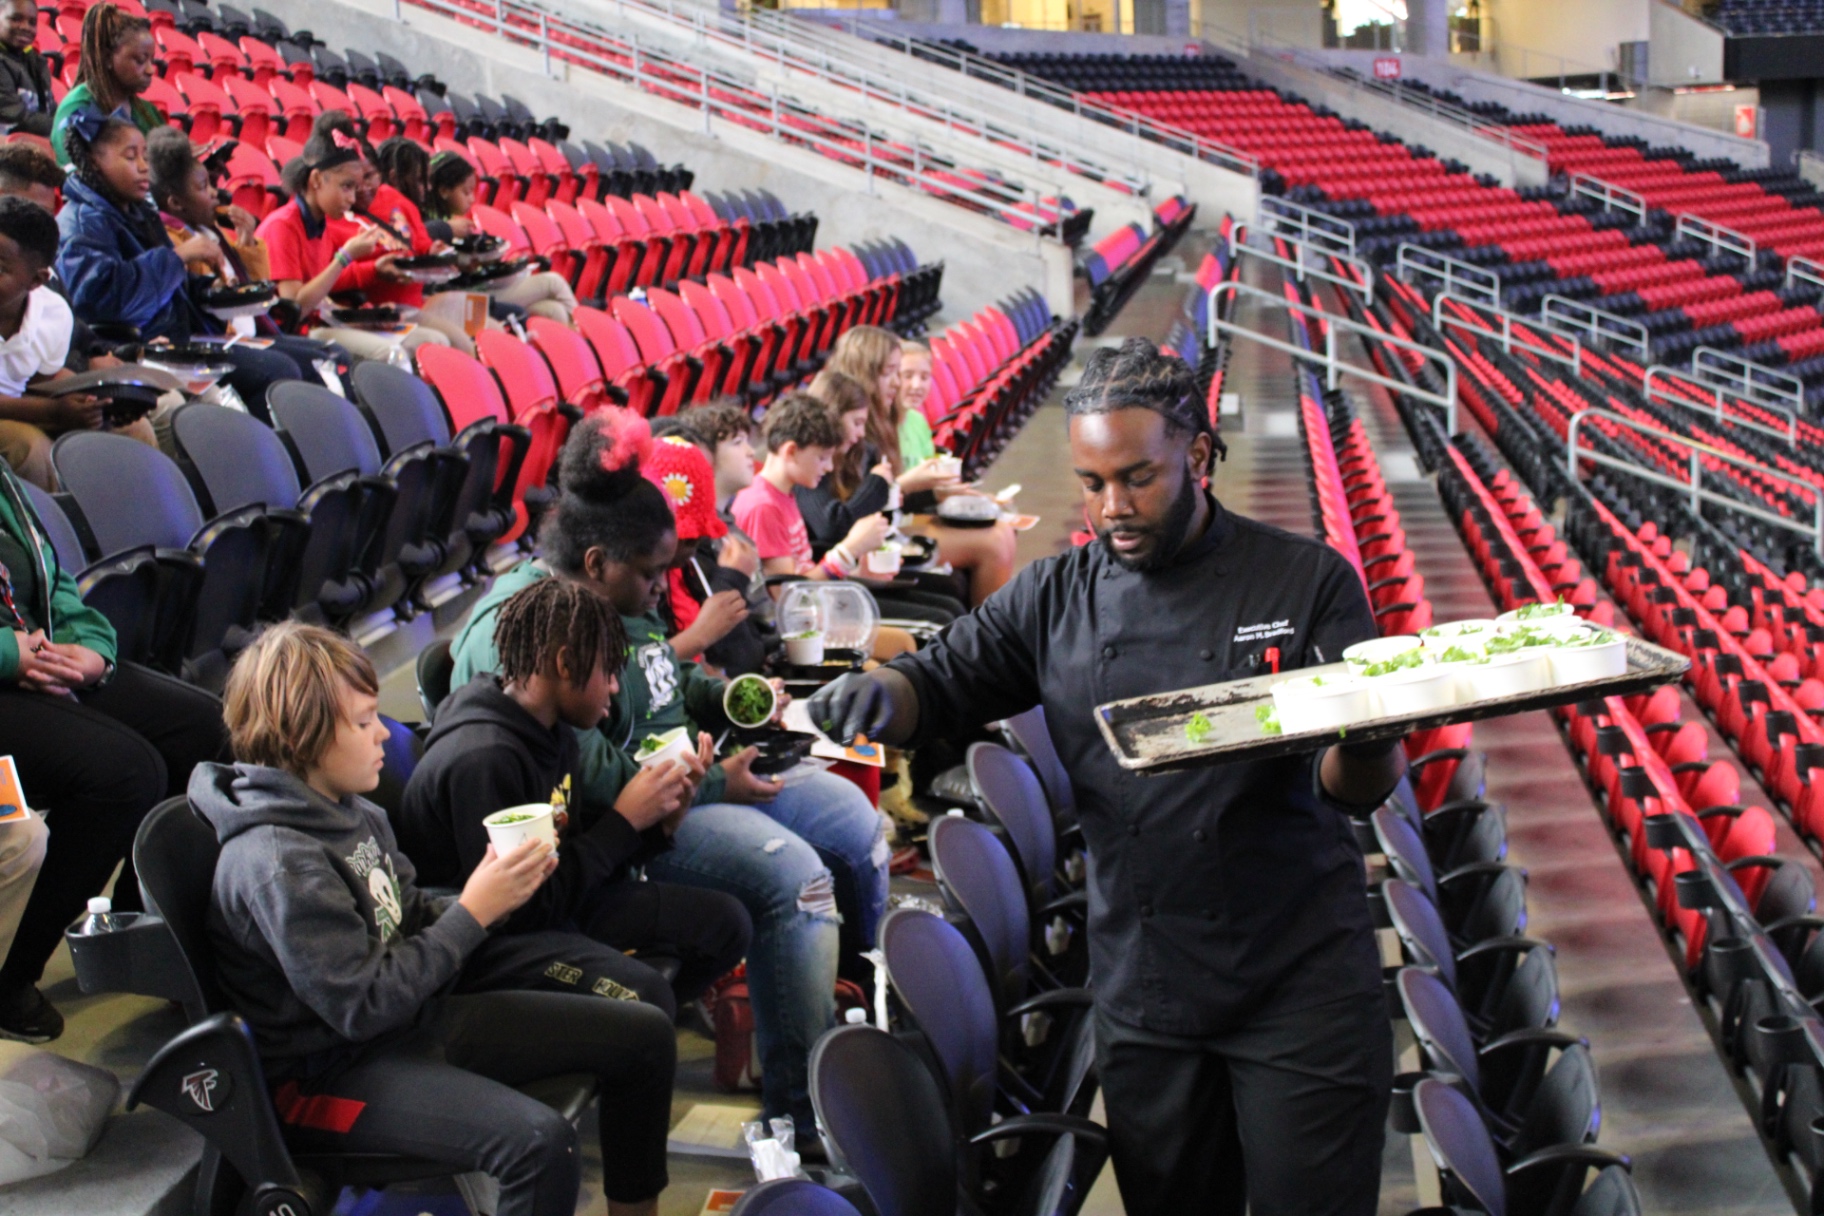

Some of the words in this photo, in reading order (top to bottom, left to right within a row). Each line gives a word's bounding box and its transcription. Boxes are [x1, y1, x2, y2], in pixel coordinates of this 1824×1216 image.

[1237, 624, 1271, 634] Executive
[1272, 619, 1289, 629] Chef
[1233, 634, 1255, 643] Aaron
